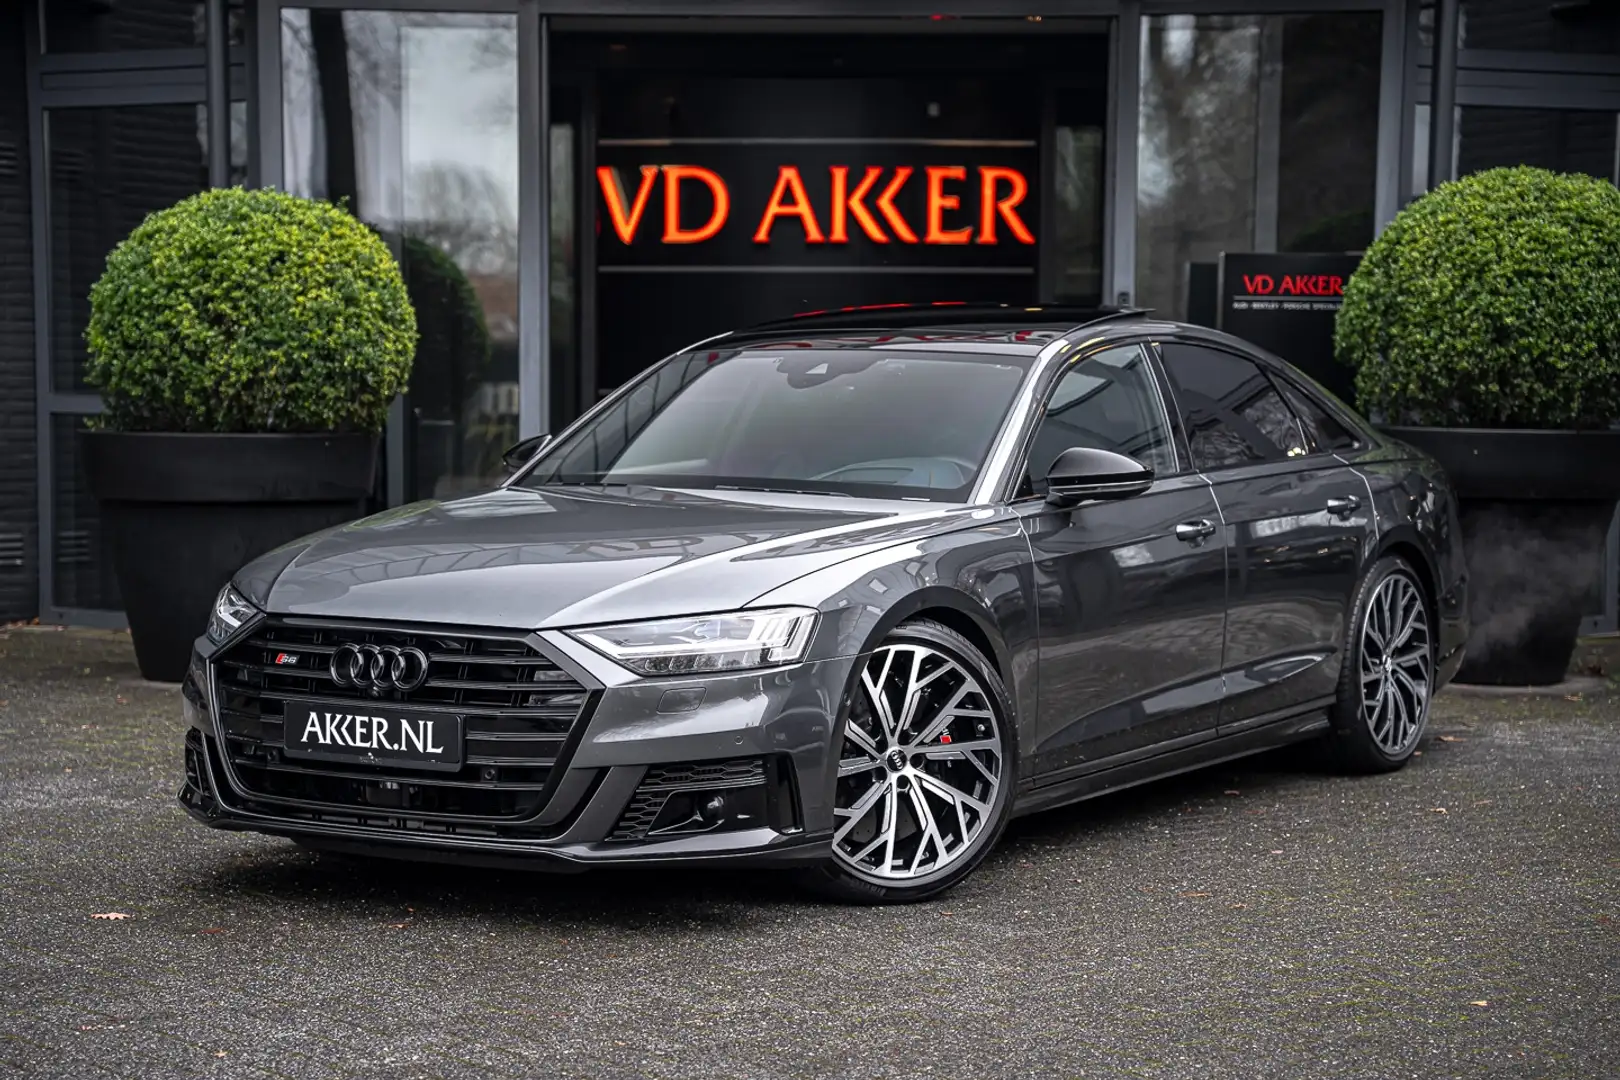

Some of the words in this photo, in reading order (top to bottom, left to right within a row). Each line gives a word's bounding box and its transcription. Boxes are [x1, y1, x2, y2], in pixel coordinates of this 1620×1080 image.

[596, 165, 730, 244] VD
[752, 165, 1036, 244] AKKER
[1243, 274, 1275, 295] VD
[1278, 274, 1344, 295] AKKER
[300, 710, 444, 754] AKKER.NL
